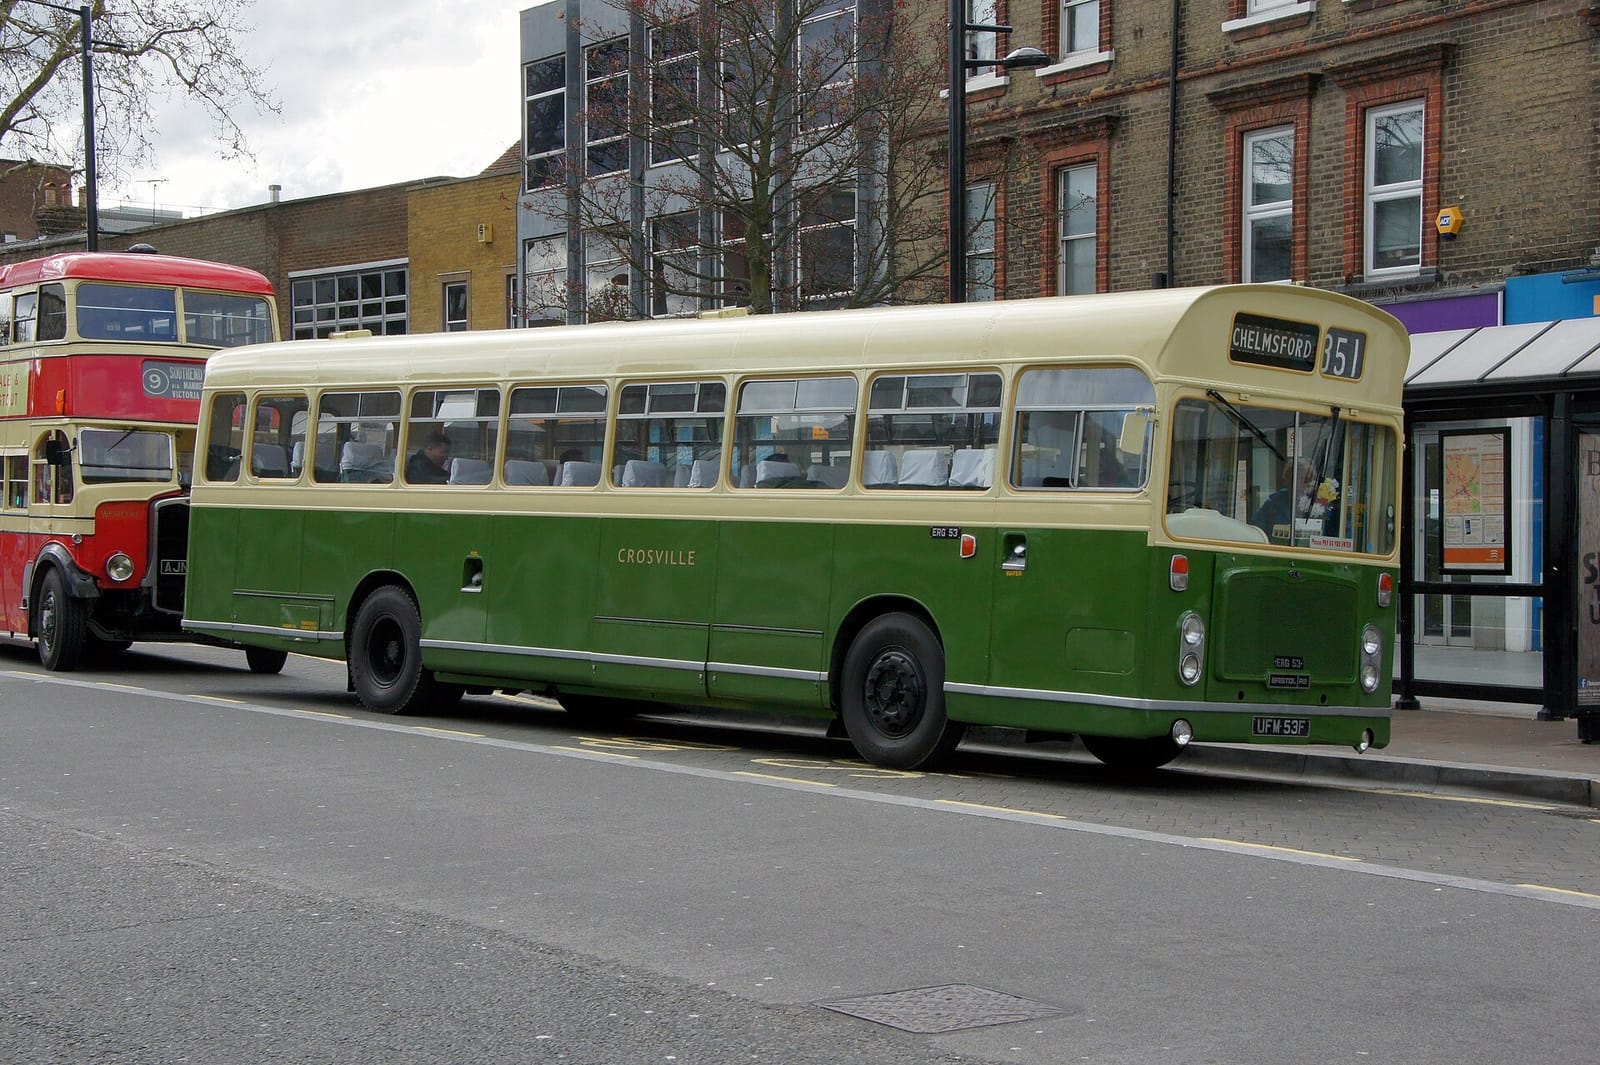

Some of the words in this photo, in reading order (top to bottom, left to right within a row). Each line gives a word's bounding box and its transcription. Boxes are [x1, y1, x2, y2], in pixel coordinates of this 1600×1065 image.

[1232, 327, 1312, 359] CHELMSFORD
[169, 366, 203, 381] SOUTHEND
[149, 374, 161, 389] 9
[171, 390, 200, 400] VICTORIA
[932, 527, 946, 537] ERG
[948, 528, 958, 537] 53
[617, 548, 696, 566] CROSVILLE
[1292, 659, 1301, 669] 53
[1257, 718, 1280, 734] UFM
[1283, 719, 1306, 735] 53F
